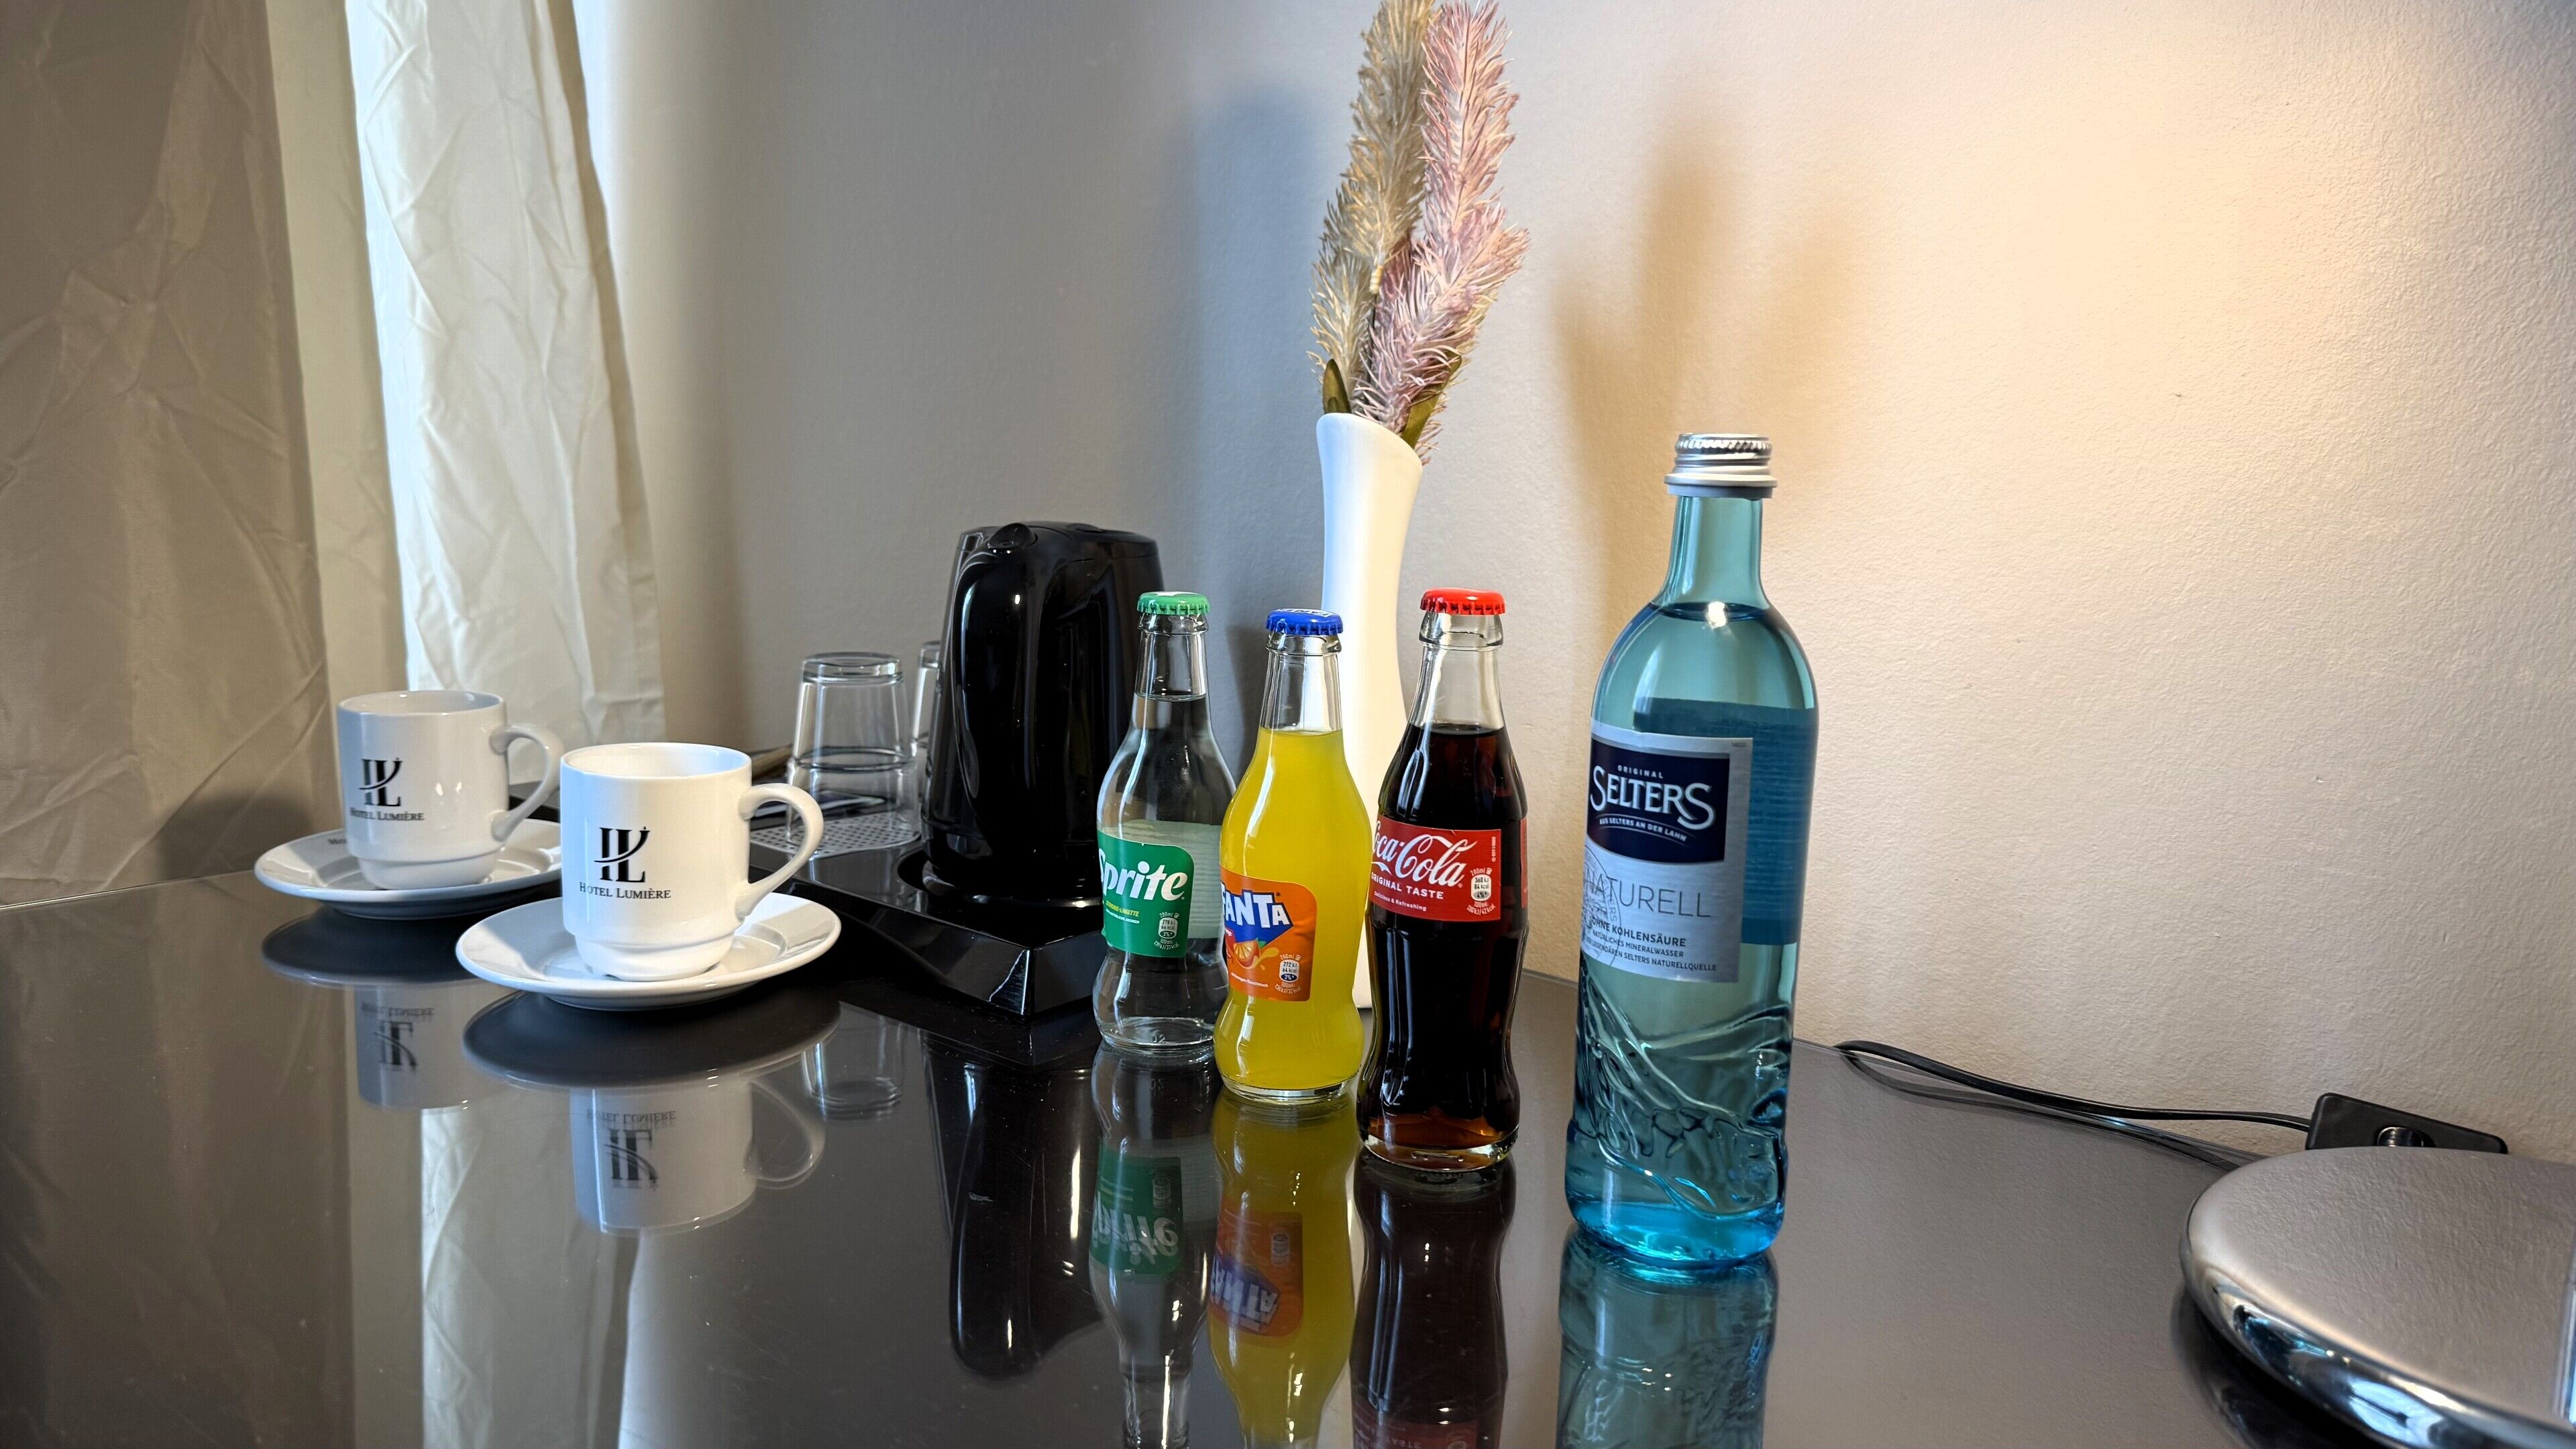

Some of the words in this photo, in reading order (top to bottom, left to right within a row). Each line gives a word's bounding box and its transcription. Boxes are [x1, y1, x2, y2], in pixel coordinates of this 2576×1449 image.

[1617, 765, 1664, 780] ORIGINAL
[1590, 765, 1716, 830] SELTERS
[377, 811, 425, 821] LUMIÈRE
[1609, 818, 1634, 826] SELTERS
[1648, 824, 1663, 833] DER
[579, 882, 612, 897] HOTEL
[616, 888, 671, 899] LUMIÈRE
[1406, 885, 1444, 900] TASTE
[1586, 867, 1711, 918] NATURELL
[1395, 899, 1427, 912] Refreshing
[1591, 918, 1610, 932] OHNE
[1612, 925, 1686, 947] KOHLENSÄURE
[1625, 943, 1684, 958] MINERALWASSER
[1623, 953, 1650, 964] SELTERS
[1652, 958, 1717, 971] NATURELLQUELLE
